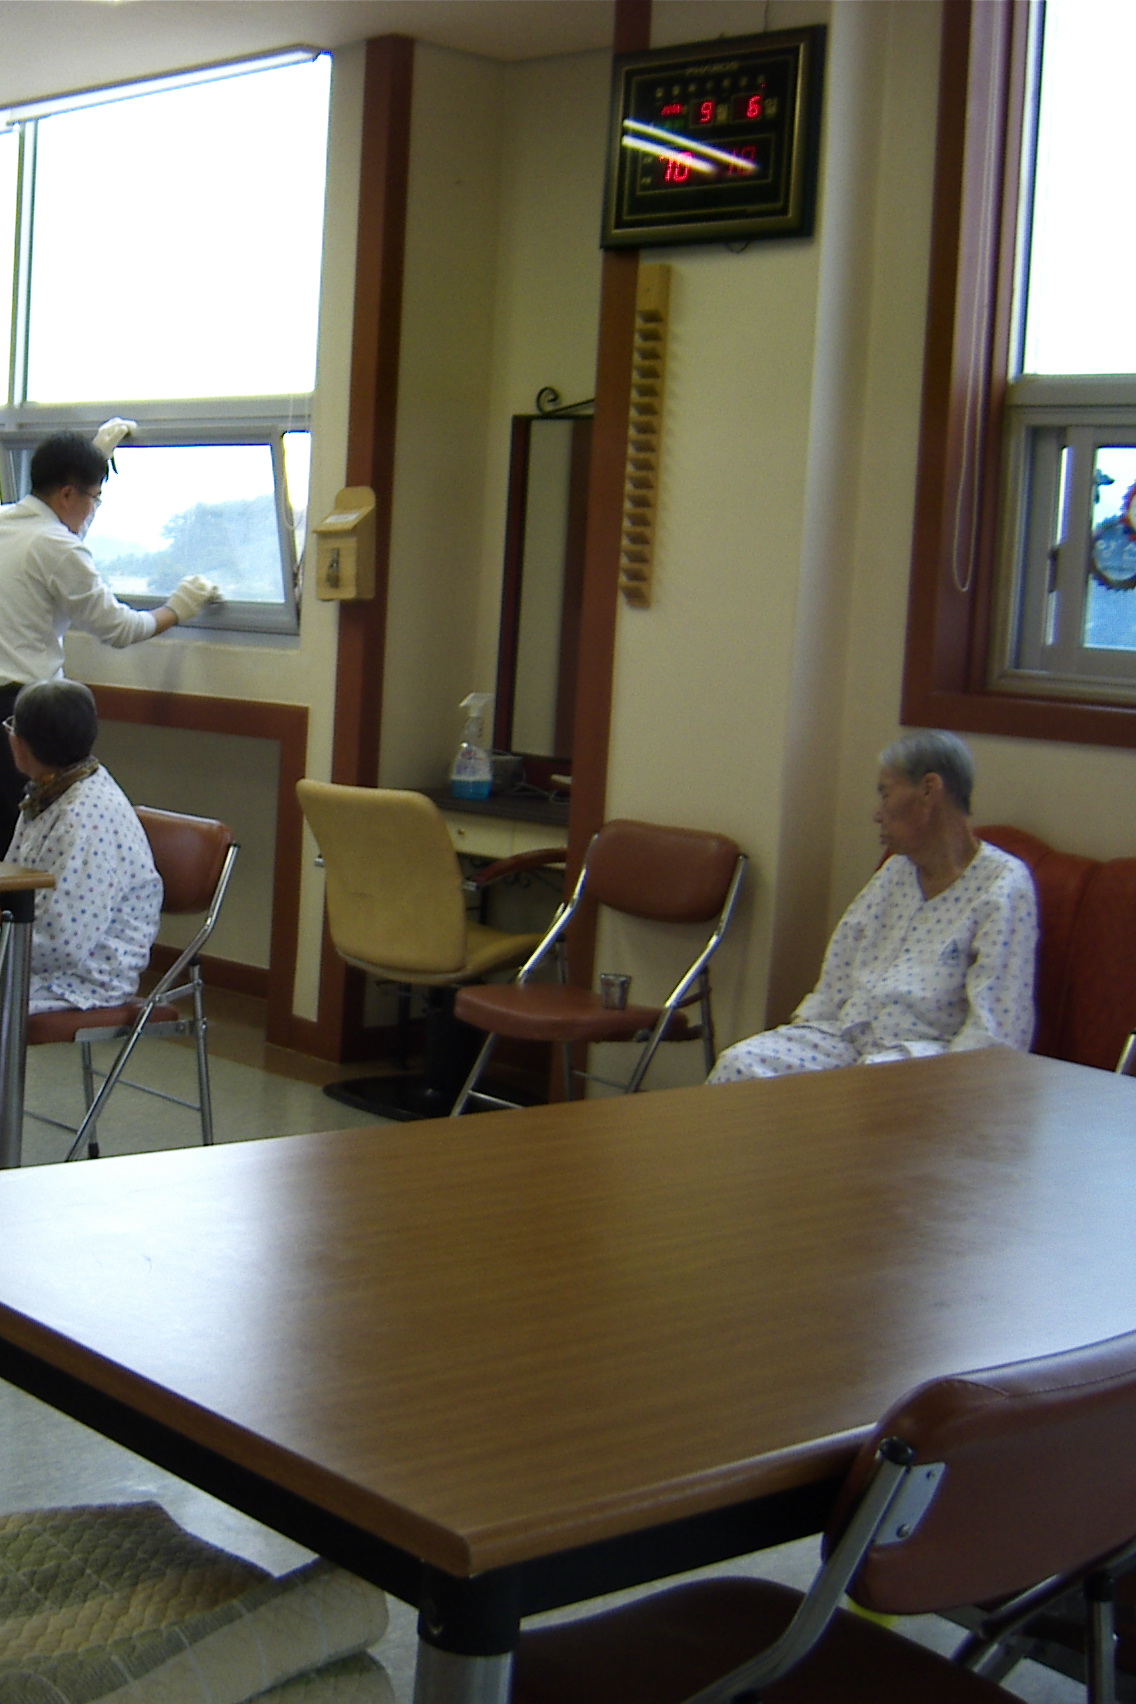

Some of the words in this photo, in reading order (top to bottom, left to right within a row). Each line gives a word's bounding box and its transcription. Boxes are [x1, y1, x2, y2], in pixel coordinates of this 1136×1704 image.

[700, 101, 714, 123] 9
[746, 95, 762, 119] 6
[664, 150, 692, 182] 10
